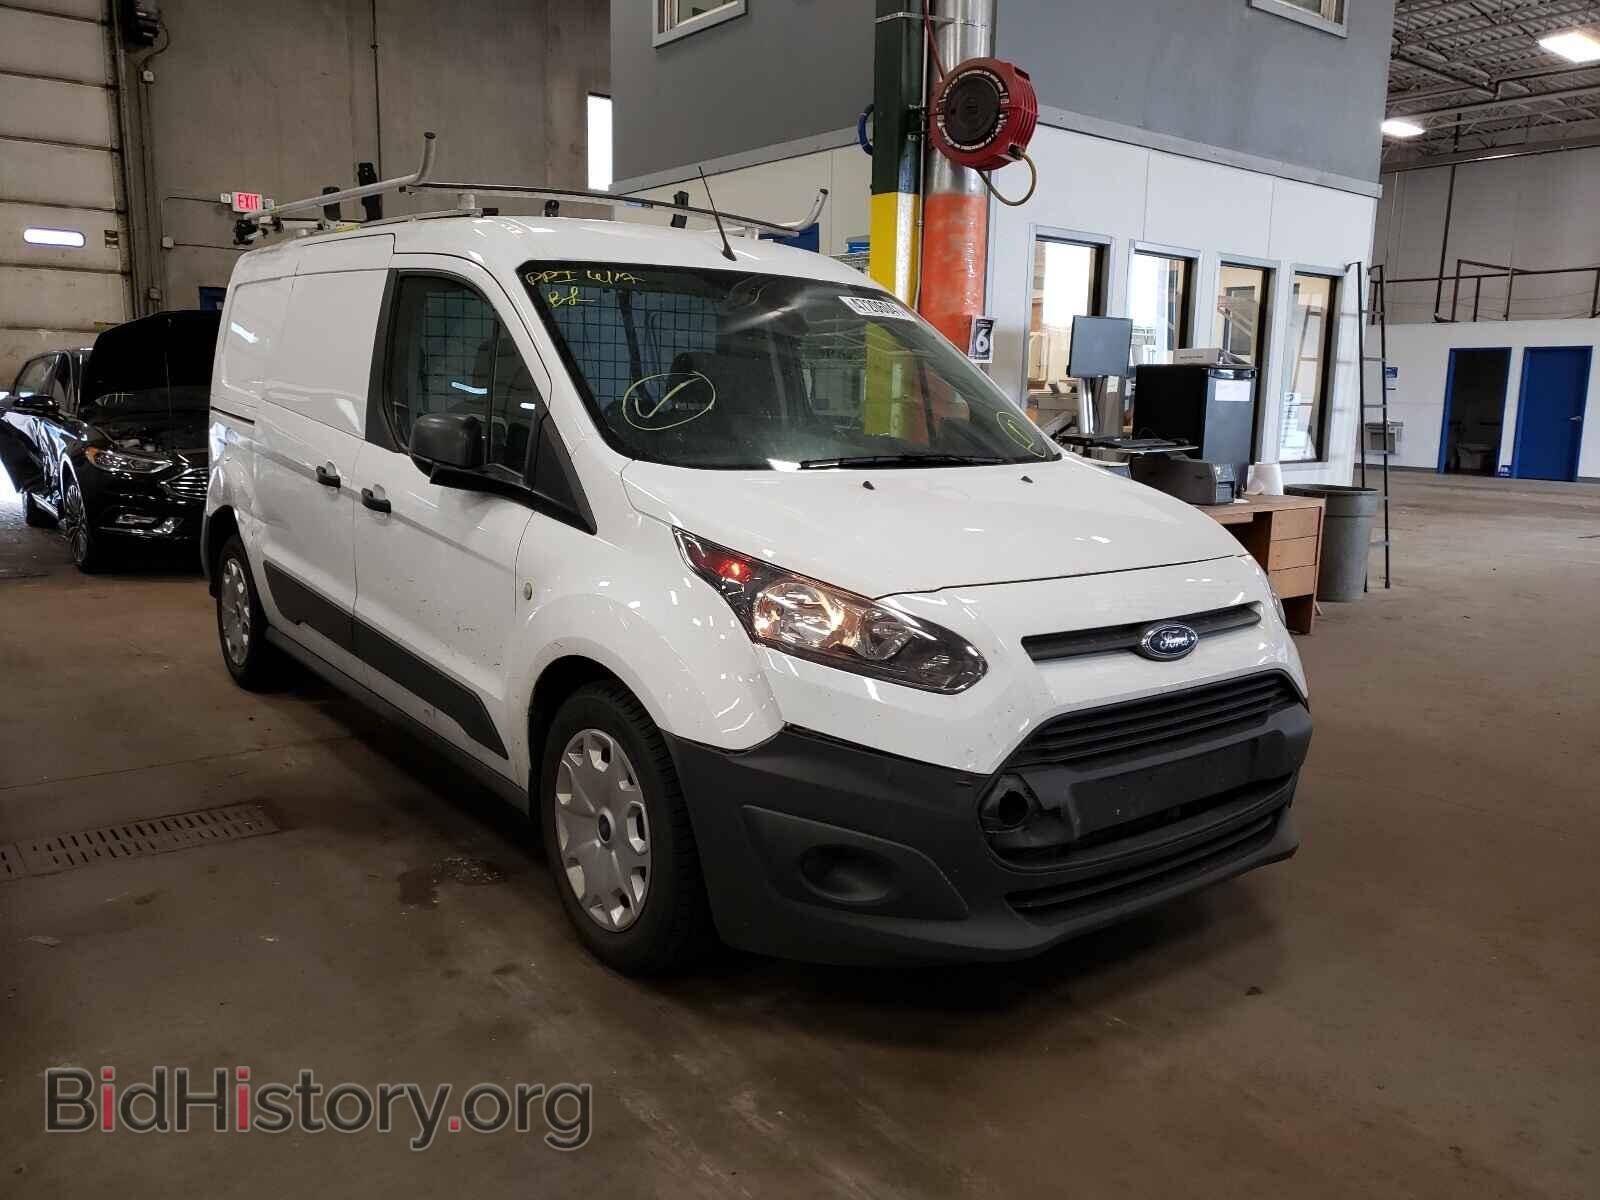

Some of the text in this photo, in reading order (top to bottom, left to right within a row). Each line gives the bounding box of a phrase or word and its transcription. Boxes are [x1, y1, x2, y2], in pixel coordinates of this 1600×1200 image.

[238, 193, 258, 210] EXIT
[975, 328, 989, 353] 6
[1160, 630, 1189, 649] Ford
